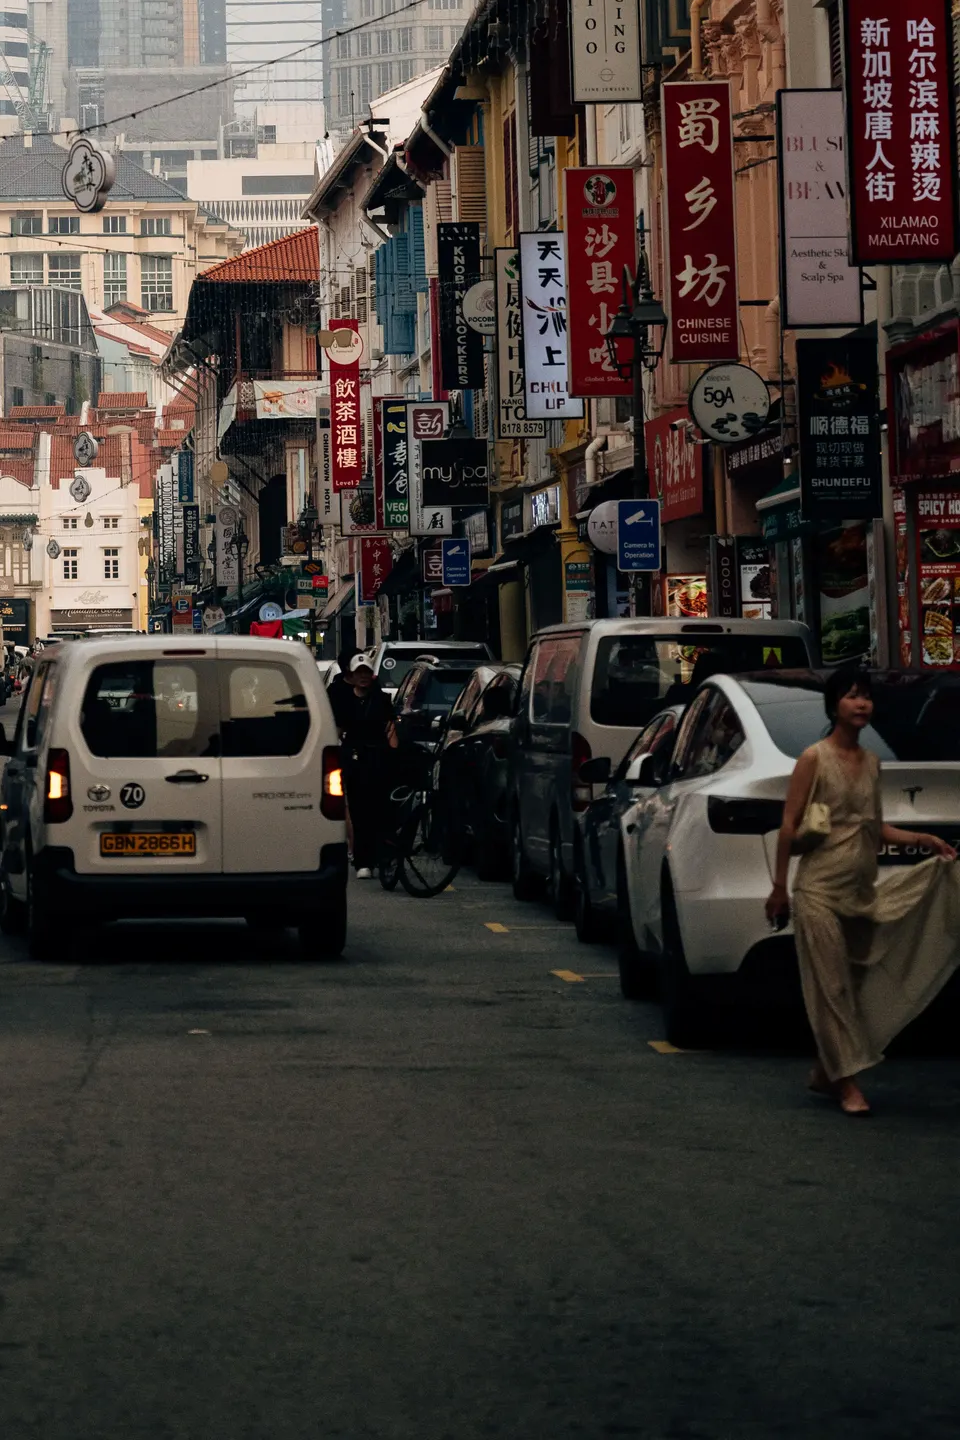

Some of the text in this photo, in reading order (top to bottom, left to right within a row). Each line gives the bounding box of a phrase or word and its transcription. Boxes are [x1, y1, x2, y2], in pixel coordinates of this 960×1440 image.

[860, 17, 896, 203] 新加坡唐人街
[906, 17, 941, 203] 哈尔滨麻辣烫
[676, 97, 731, 308] 蜀乡坊
[880, 215, 938, 230] XILAMAO
[868, 232, 939, 248] MALATANG
[790, 248, 833, 259] Aesthetic
[818, 261, 827, 270] &
[801, 272, 844, 284] Scalp Spa
[584, 223, 619, 372] 沙县小吃
[677, 317, 732, 330] CHINESE
[454, 305, 469, 386] KNOCKERS
[680, 332, 730, 344] CUISINE
[545, 398, 565, 410] UP
[334, 378, 358, 469] 飲茶酒樓
[502, 422, 543, 434] 8178 8579
[810, 415, 870, 436] 顺德福
[815, 441, 865, 455] 现切现做
[811, 477, 871, 488] SHUNDEFU
[918, 499, 945, 517] SPICY
[623, 541, 655, 549] Camera In
[624, 551, 655, 560] Operation
[721, 556, 732, 598] FOOD
[123, 786, 144, 801] 70
[83, 804, 116, 814] TOYOTA
[103, 833, 136, 851] GBN
[182, 833, 194, 851] H
